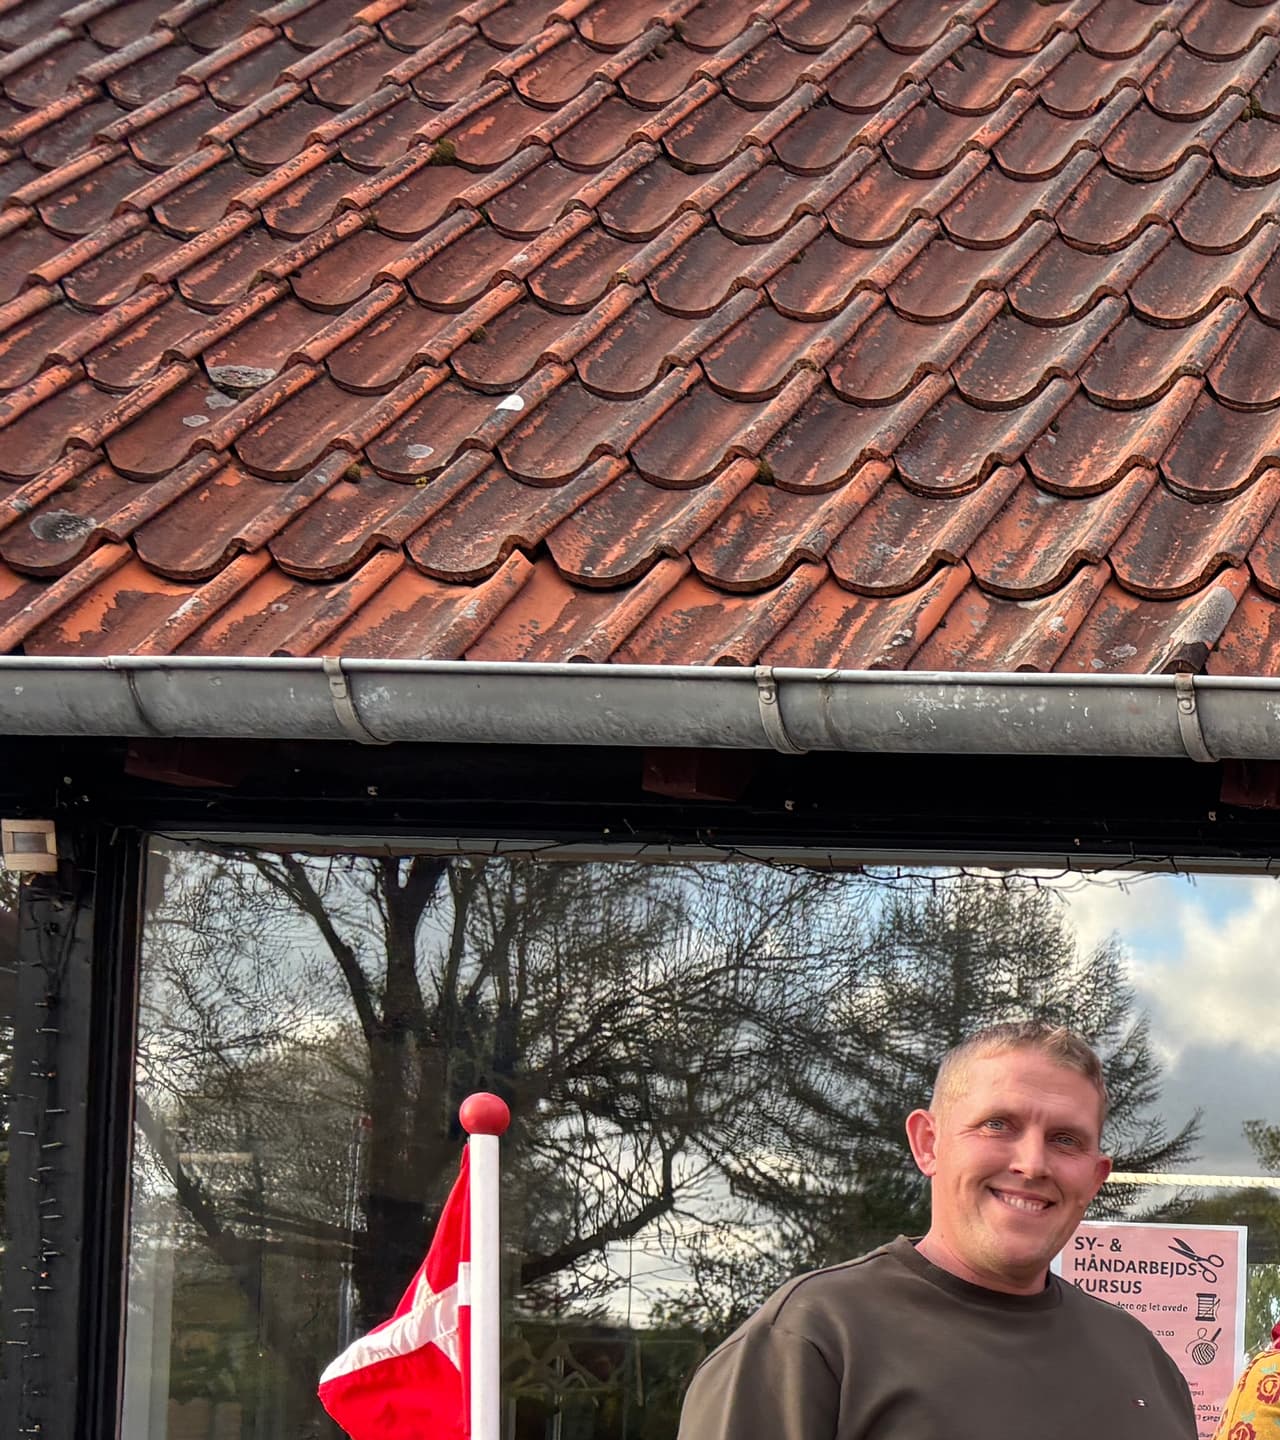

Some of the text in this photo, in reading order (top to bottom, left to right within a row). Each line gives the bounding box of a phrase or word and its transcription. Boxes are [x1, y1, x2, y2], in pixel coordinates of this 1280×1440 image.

[1074, 1236, 1122, 1252] SY- &
[1074, 1253, 1202, 1278] HÅNDARBEJDS-
[1074, 1278, 1143, 1294] KURSUS
